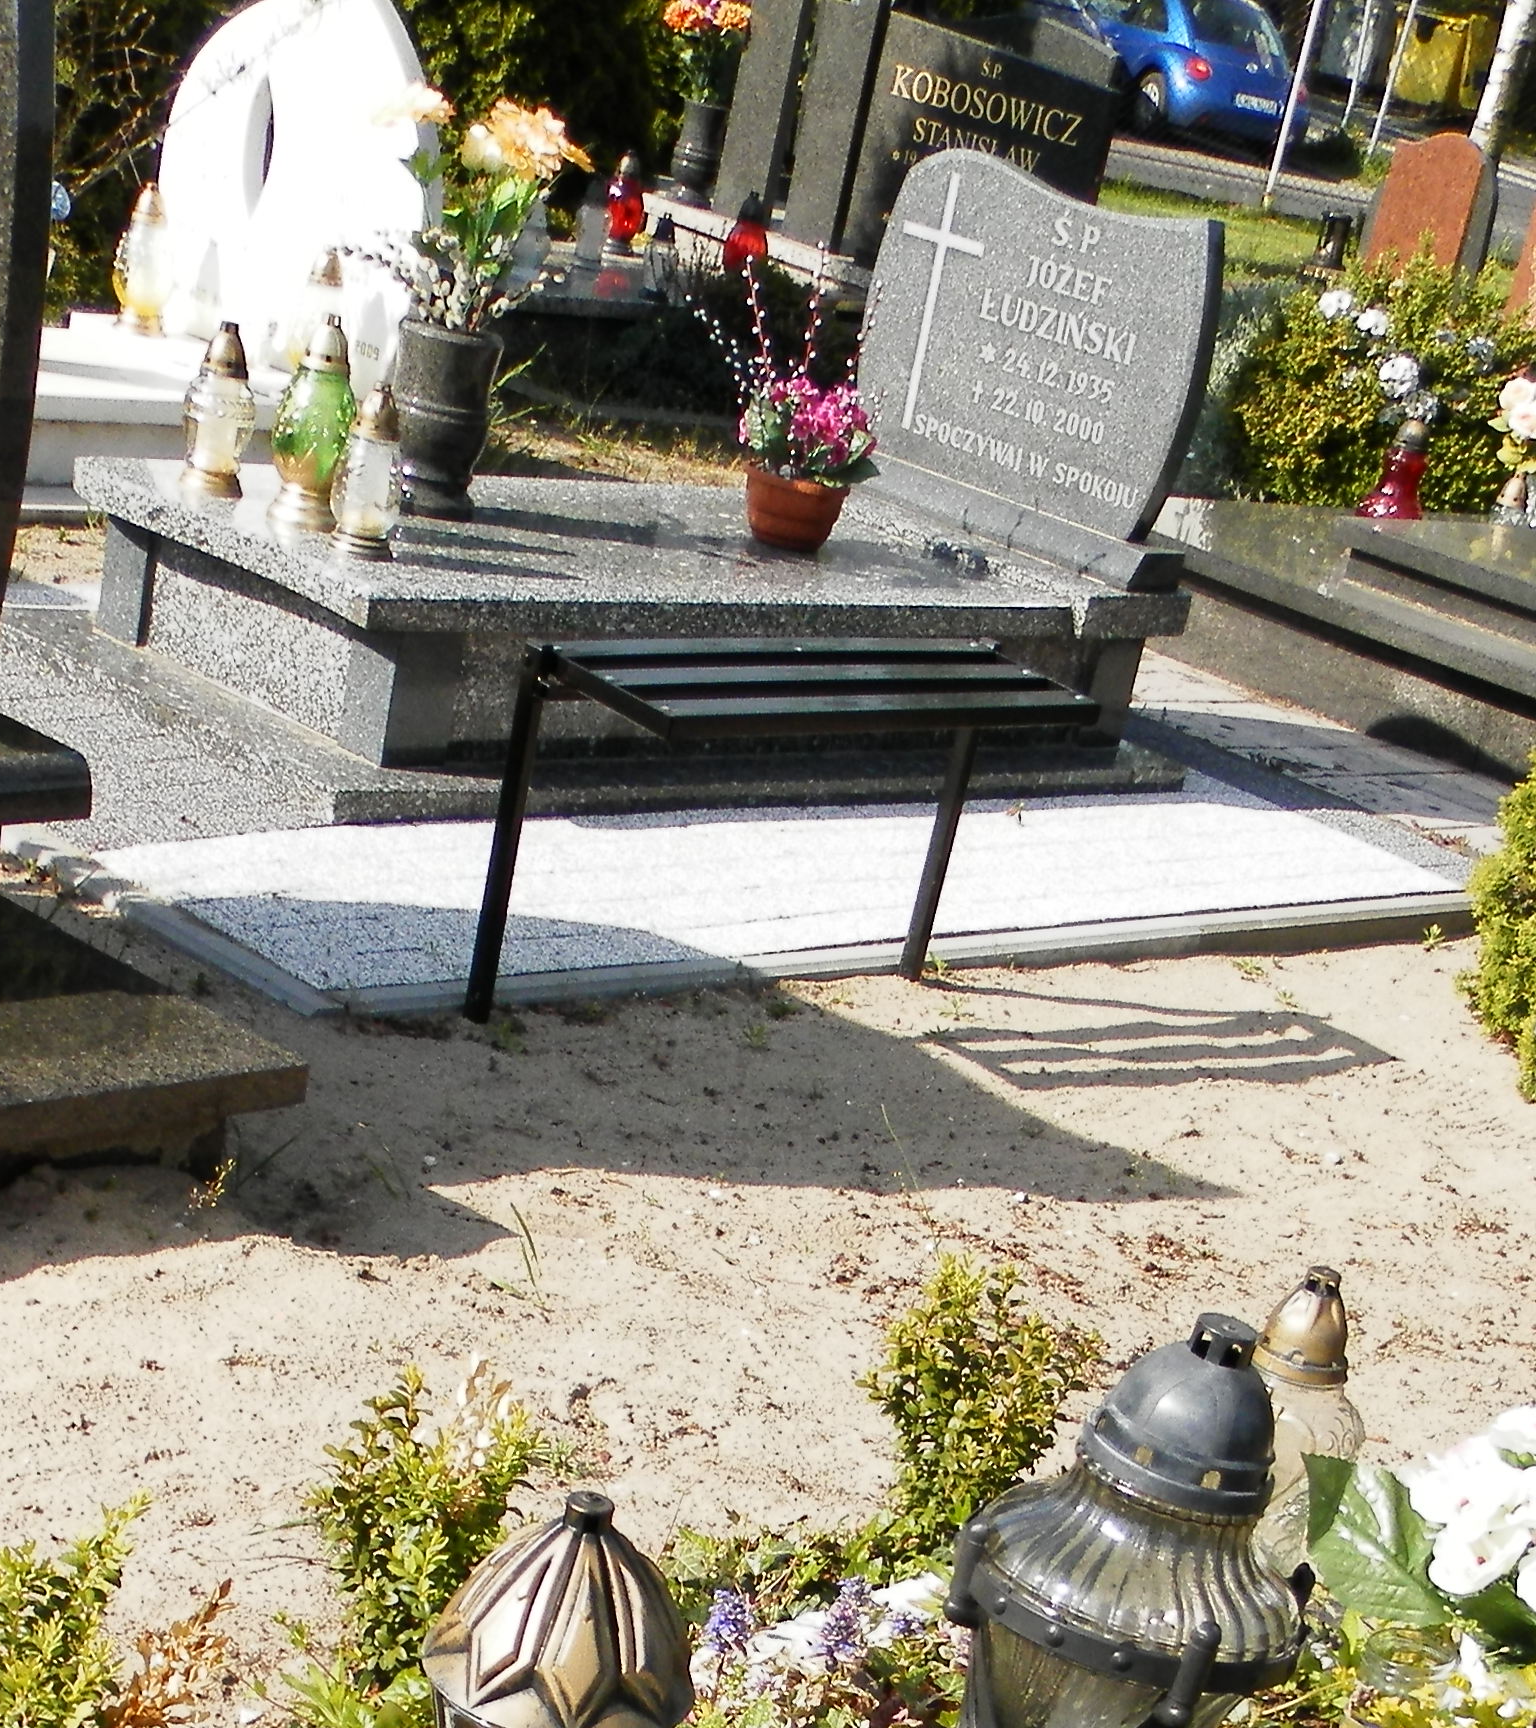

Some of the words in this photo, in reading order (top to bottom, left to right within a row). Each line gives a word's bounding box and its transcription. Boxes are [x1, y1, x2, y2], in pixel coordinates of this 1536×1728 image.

[890, 64, 1083, 147] KOBOSOWICZ
[1026, 252, 1113, 307] JÓZEF
[979, 287, 1137, 366] ŁUDZIŃSKI
[913, 413, 1024, 473] SPOCZYWAJ
[1029, 452, 1050, 478] W
[1052, 462, 1139, 510] SPOKOJU
